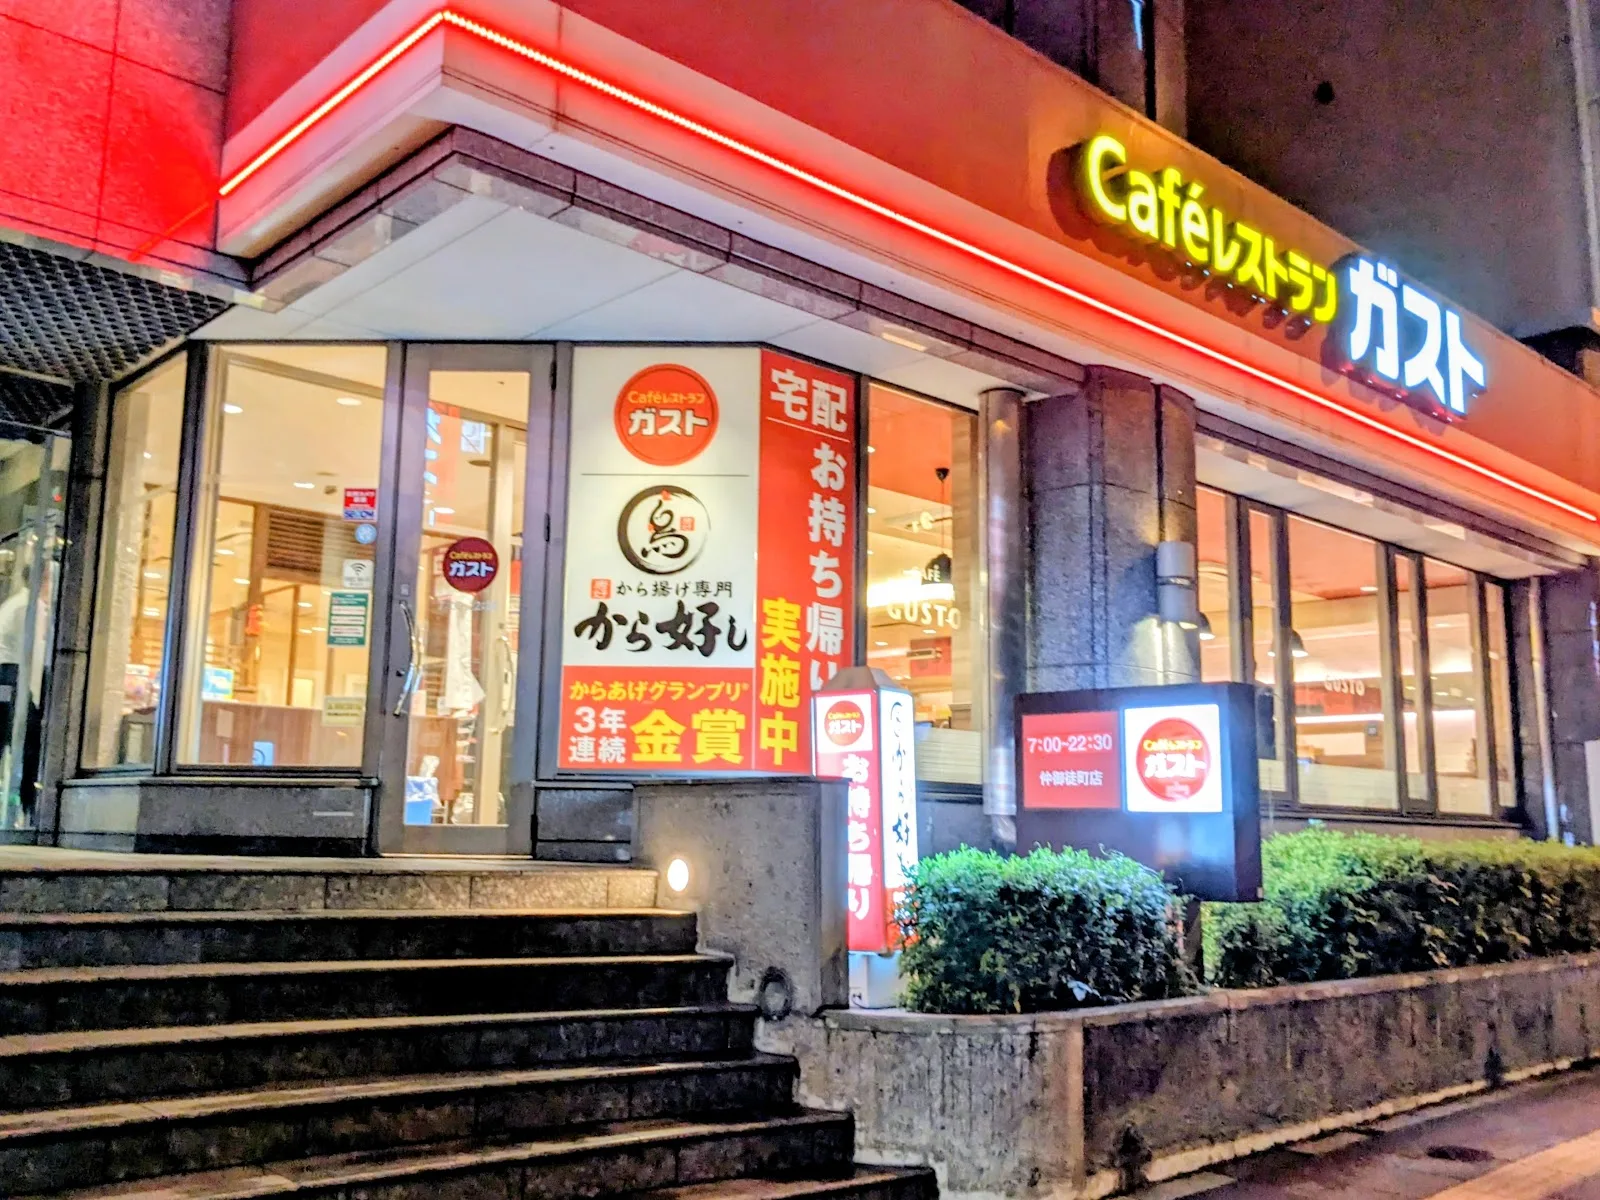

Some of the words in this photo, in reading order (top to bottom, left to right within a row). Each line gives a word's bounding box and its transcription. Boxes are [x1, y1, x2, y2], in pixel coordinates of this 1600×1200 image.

[1346, 256, 1486, 415] ガスト
[770, 368, 848, 433] 宅配
[628, 407, 709, 436] ガスト
[448, 560, 495, 577] ガスト
[616, 580, 733, 598] から揚げ専門
[574, 599, 748, 657] から好し
[887, 601, 961, 630] GUSTO
[760, 597, 801, 766] 実施中
[573, 706, 627, 734] 3年
[568, 736, 626, 764] 連続
[630, 708, 746, 765] 金賞
[1144, 752, 1207, 778] ガスト
